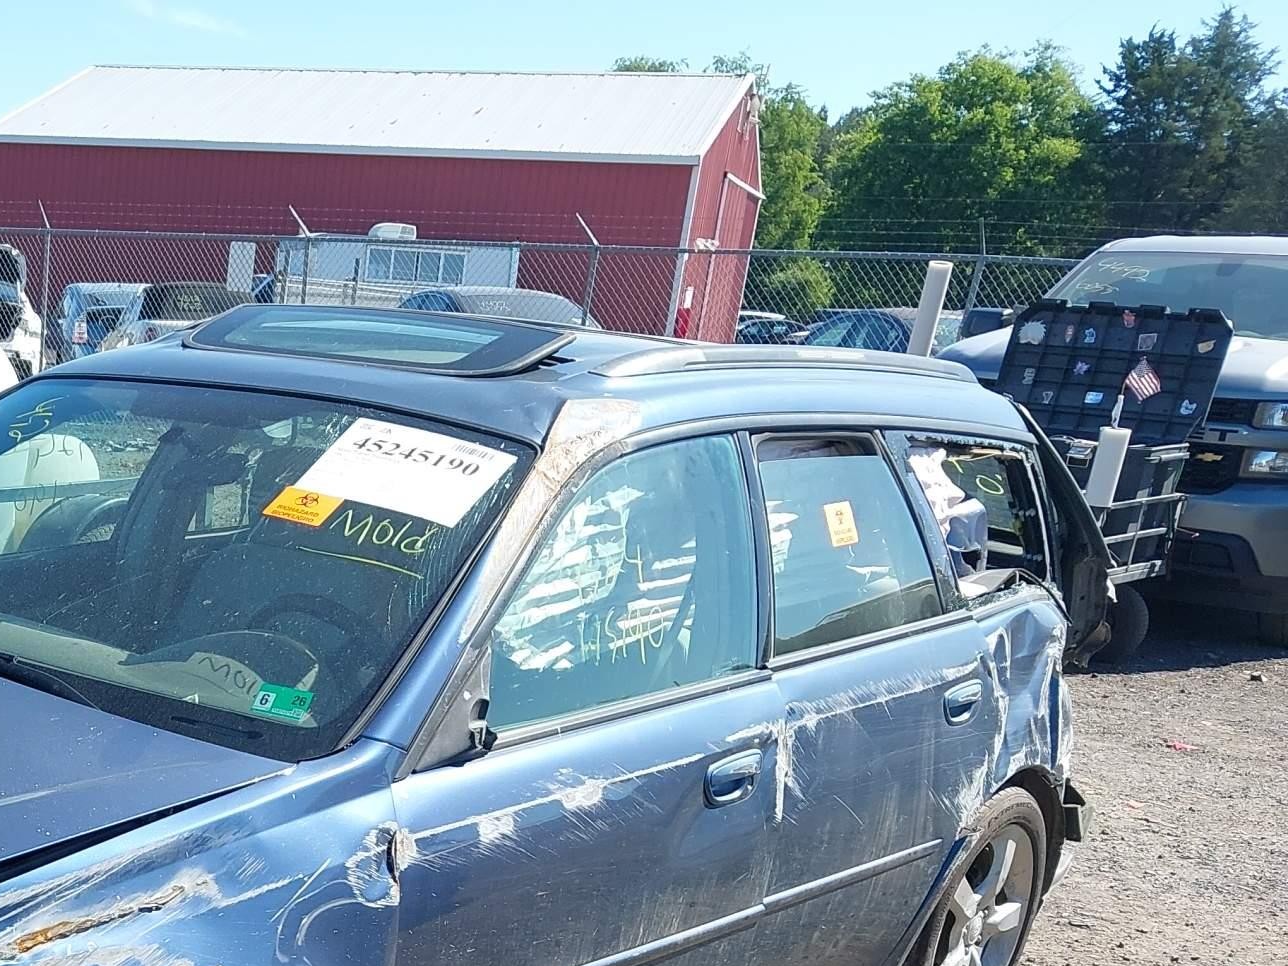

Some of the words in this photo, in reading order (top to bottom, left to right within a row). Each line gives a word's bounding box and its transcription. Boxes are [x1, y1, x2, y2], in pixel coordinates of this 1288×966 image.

[353, 436, 480, 477] 45245190
[260, 693, 270, 706] 6
[291, 695, 308, 707] 26
